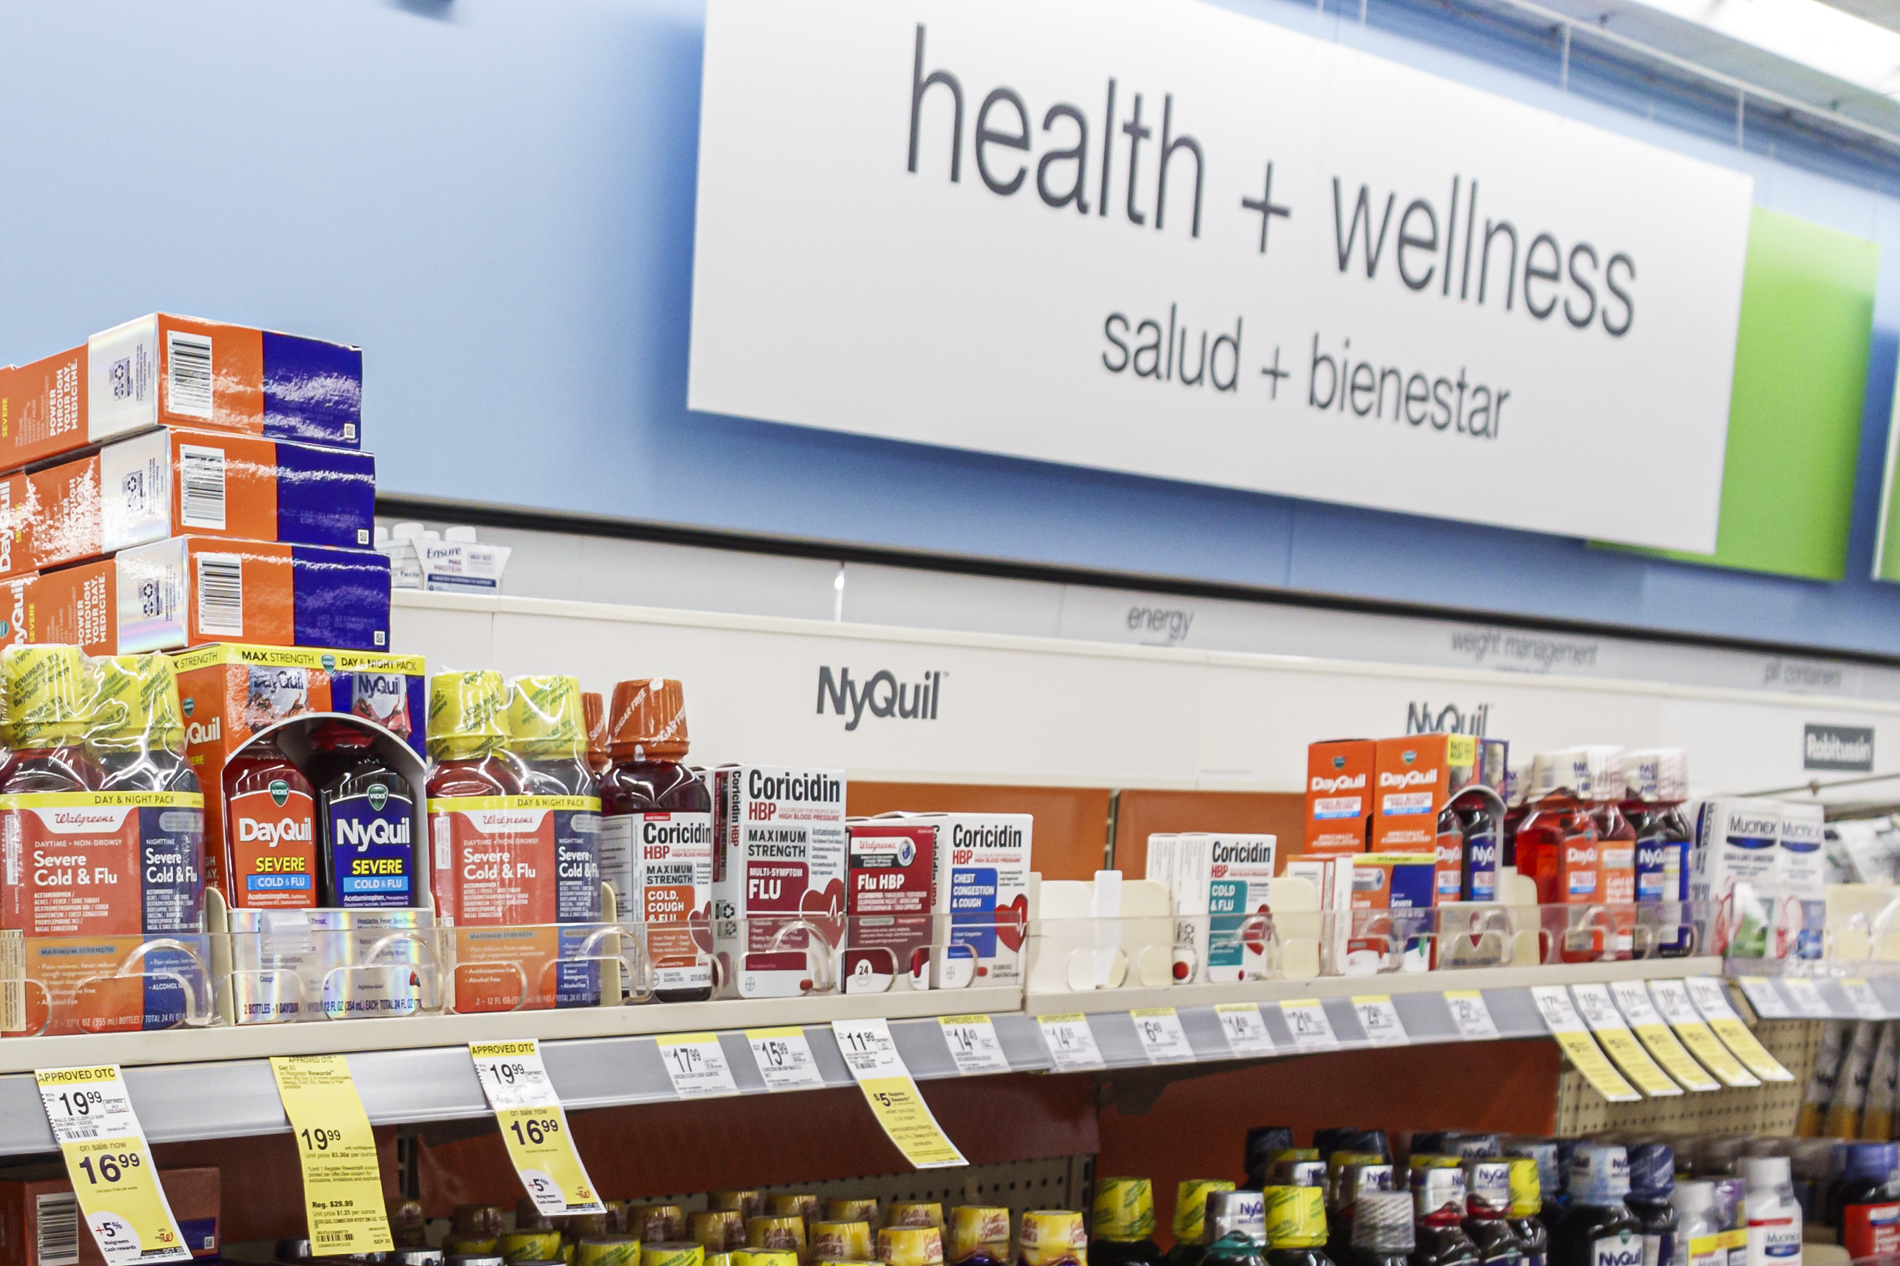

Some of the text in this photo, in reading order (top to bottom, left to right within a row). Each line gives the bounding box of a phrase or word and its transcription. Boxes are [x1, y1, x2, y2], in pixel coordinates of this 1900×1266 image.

[908, 23, 1636, 338] health + wellness
[1102, 302, 1511, 441] salud + bienestar
[1128, 608, 1192, 646] energy
[1451, 629, 1499, 662] weight
[817, 666, 941, 731] NyQuil
[748, 769, 840, 802] Coricidin
[1379, 768, 1438, 789] DayQuil
[55, 812, 114, 826] Walgreens
[749, 802, 777, 821] HBP
[337, 818, 411, 850] NyQuil
[748, 830, 806, 843] MAXIMUM
[953, 824, 1022, 848] Coricidin
[748, 843, 806, 858] STRENGTH
[1211, 841, 1271, 864] Coricidin
[34, 851, 86, 867] Severe
[33, 869, 117, 885] Cold & Flu
[749, 867, 803, 877] MULTI-SYMPTOM
[953, 874, 975, 884] CHEST
[748, 878, 782, 900] FLU
[857, 874, 905, 890] Flu HBP
[953, 885, 995, 896] CONGESTION
[1211, 884, 1236, 898] COLD
[953, 897, 982, 908] & COUGH
[1220, 898, 1235, 911] FLU
[39, 1068, 115, 1083] APPROVED OTC
